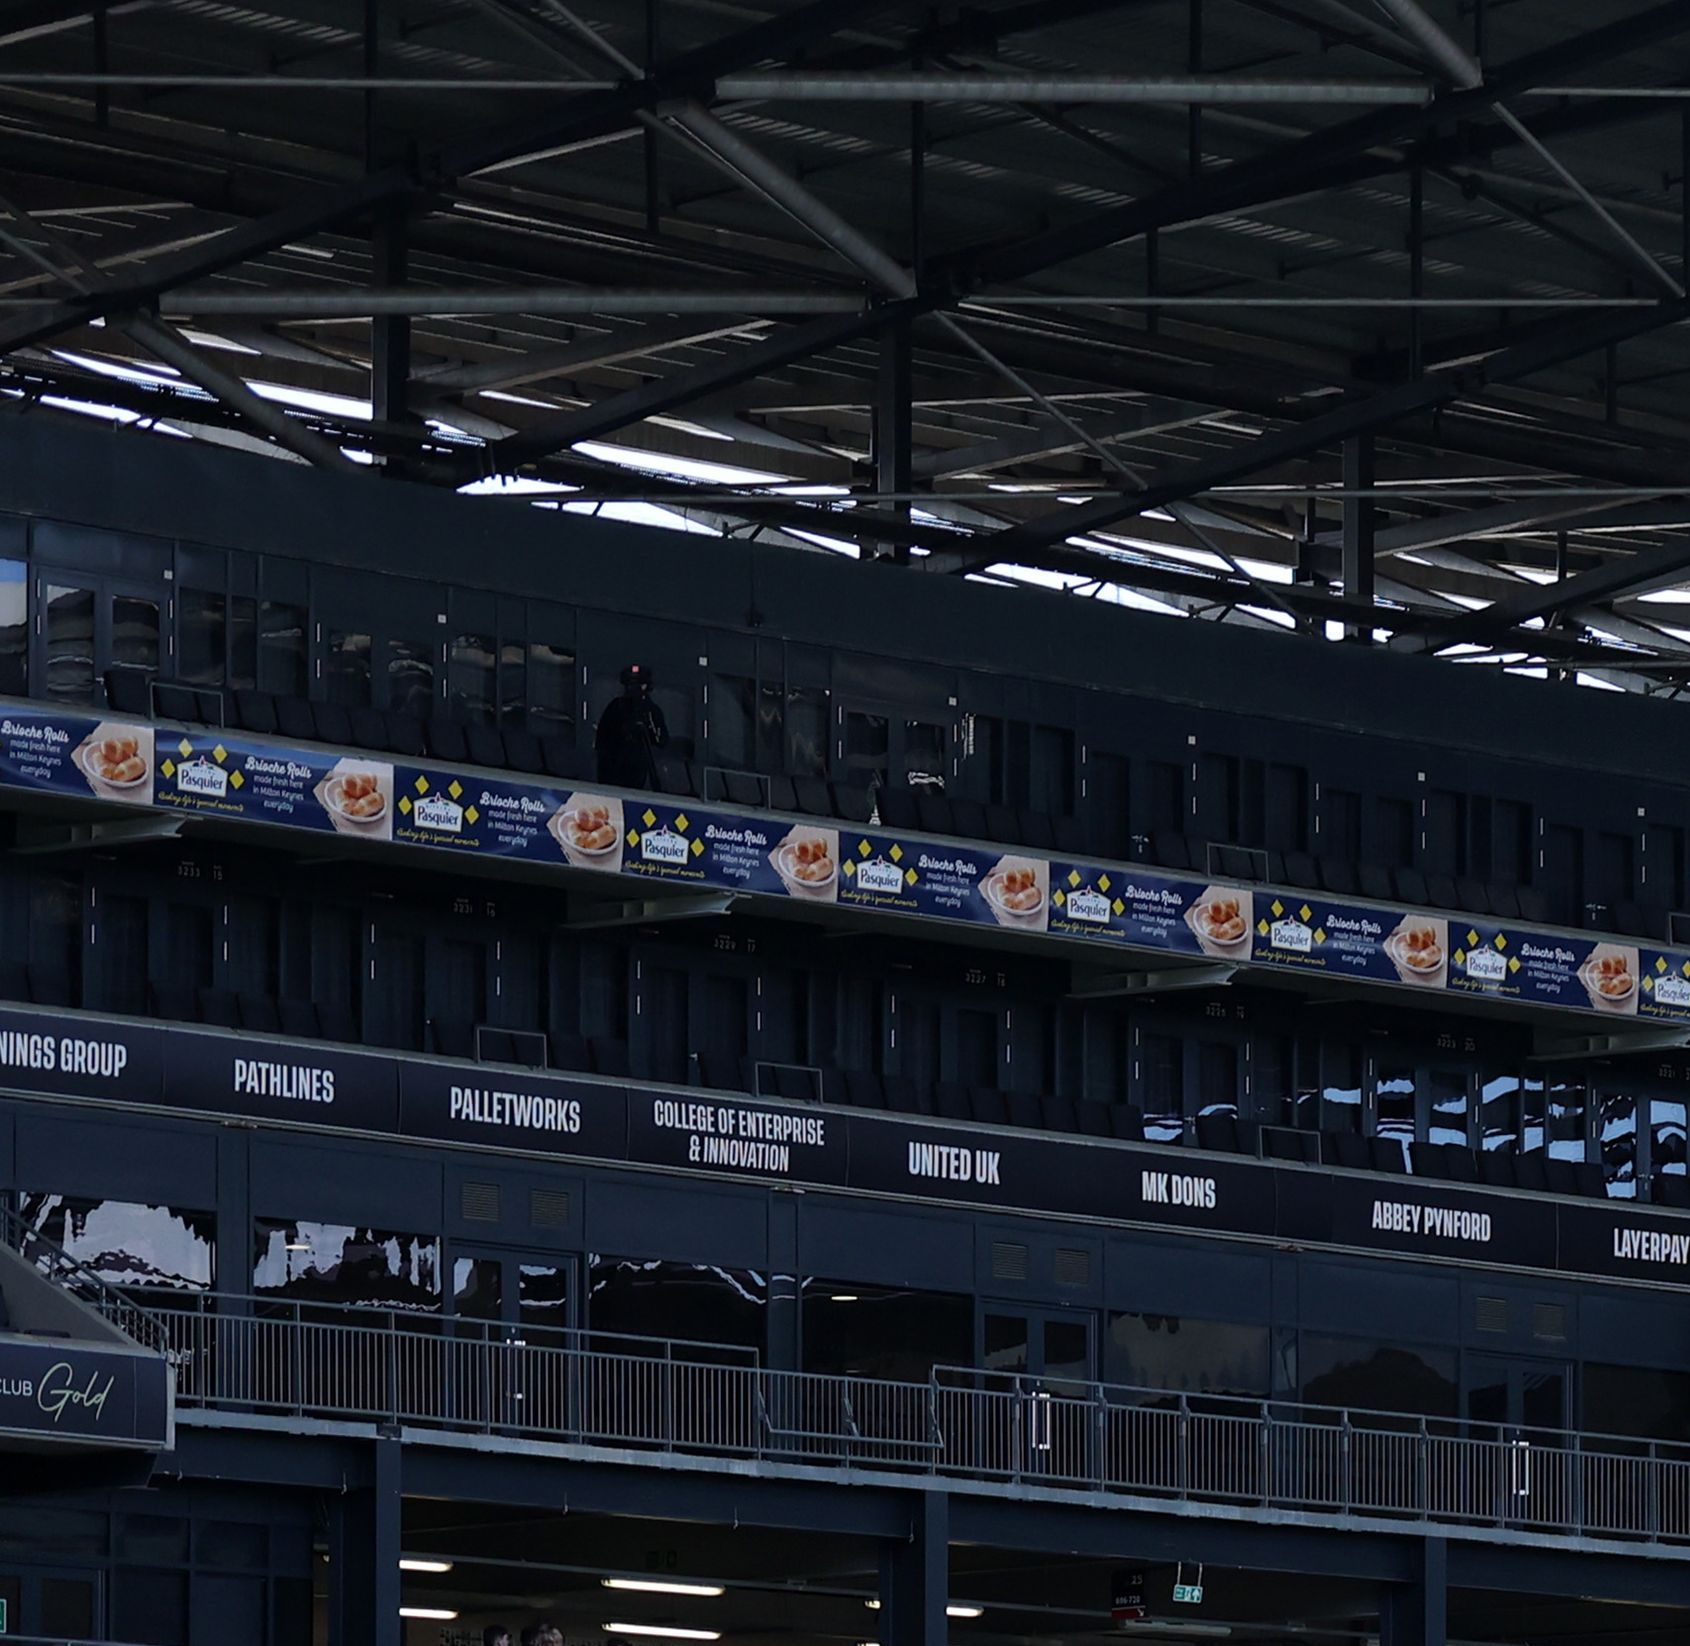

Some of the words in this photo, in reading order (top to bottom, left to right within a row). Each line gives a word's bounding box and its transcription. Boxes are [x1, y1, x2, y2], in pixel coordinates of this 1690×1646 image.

[1, 720, 42, 740] Brioche
[43, 727, 70, 744] Rolls
[181, 769, 223, 790] Pasquier
[245, 756, 286, 776] Brioche
[287, 762, 312, 779] Rolls
[481, 791, 520, 808] Brioche
[520, 796, 545, 813] Rolls
[418, 805, 459, 826] Pasquier
[705, 824, 742, 841] Brioche
[743, 829, 767, 846] Rolls
[645, 839, 684, 860] Pasquier
[918, 854, 954, 873] Brioche
[955, 859, 977, 877] Rolls
[859, 871, 900, 891] Pasquier
[1125, 884, 1160, 902] Brioche
[1162, 890, 1183, 908] Rolls
[1069, 900, 1108, 920] Pasquier
[60, 1038, 127, 1078] GROUP
[234, 1059, 335, 1103] PATHLINES
[450, 1086, 581, 1134] PALLETWORKS
[654, 1099, 715, 1133] COLLEGE
[718, 1107, 736, 1135] OF
[739, 1110, 825, 1146] ENTERPRISE
[689, 1135, 701, 1162] &
[703, 1136, 789, 1172] INNOVATION
[909, 1141, 971, 1181] UNITED
[975, 1150, 1000, 1186] UK
[1142, 1170, 1168, 1204] MK
[1171, 1175, 1216, 1208] DONS
[1372, 1200, 1421, 1235] ABBEY
[1424, 1206, 1491, 1242] PYNFORD
[1613, 1228, 1690, 1265] LAYERPAY
[37, 1362, 114, 1423] Gold
